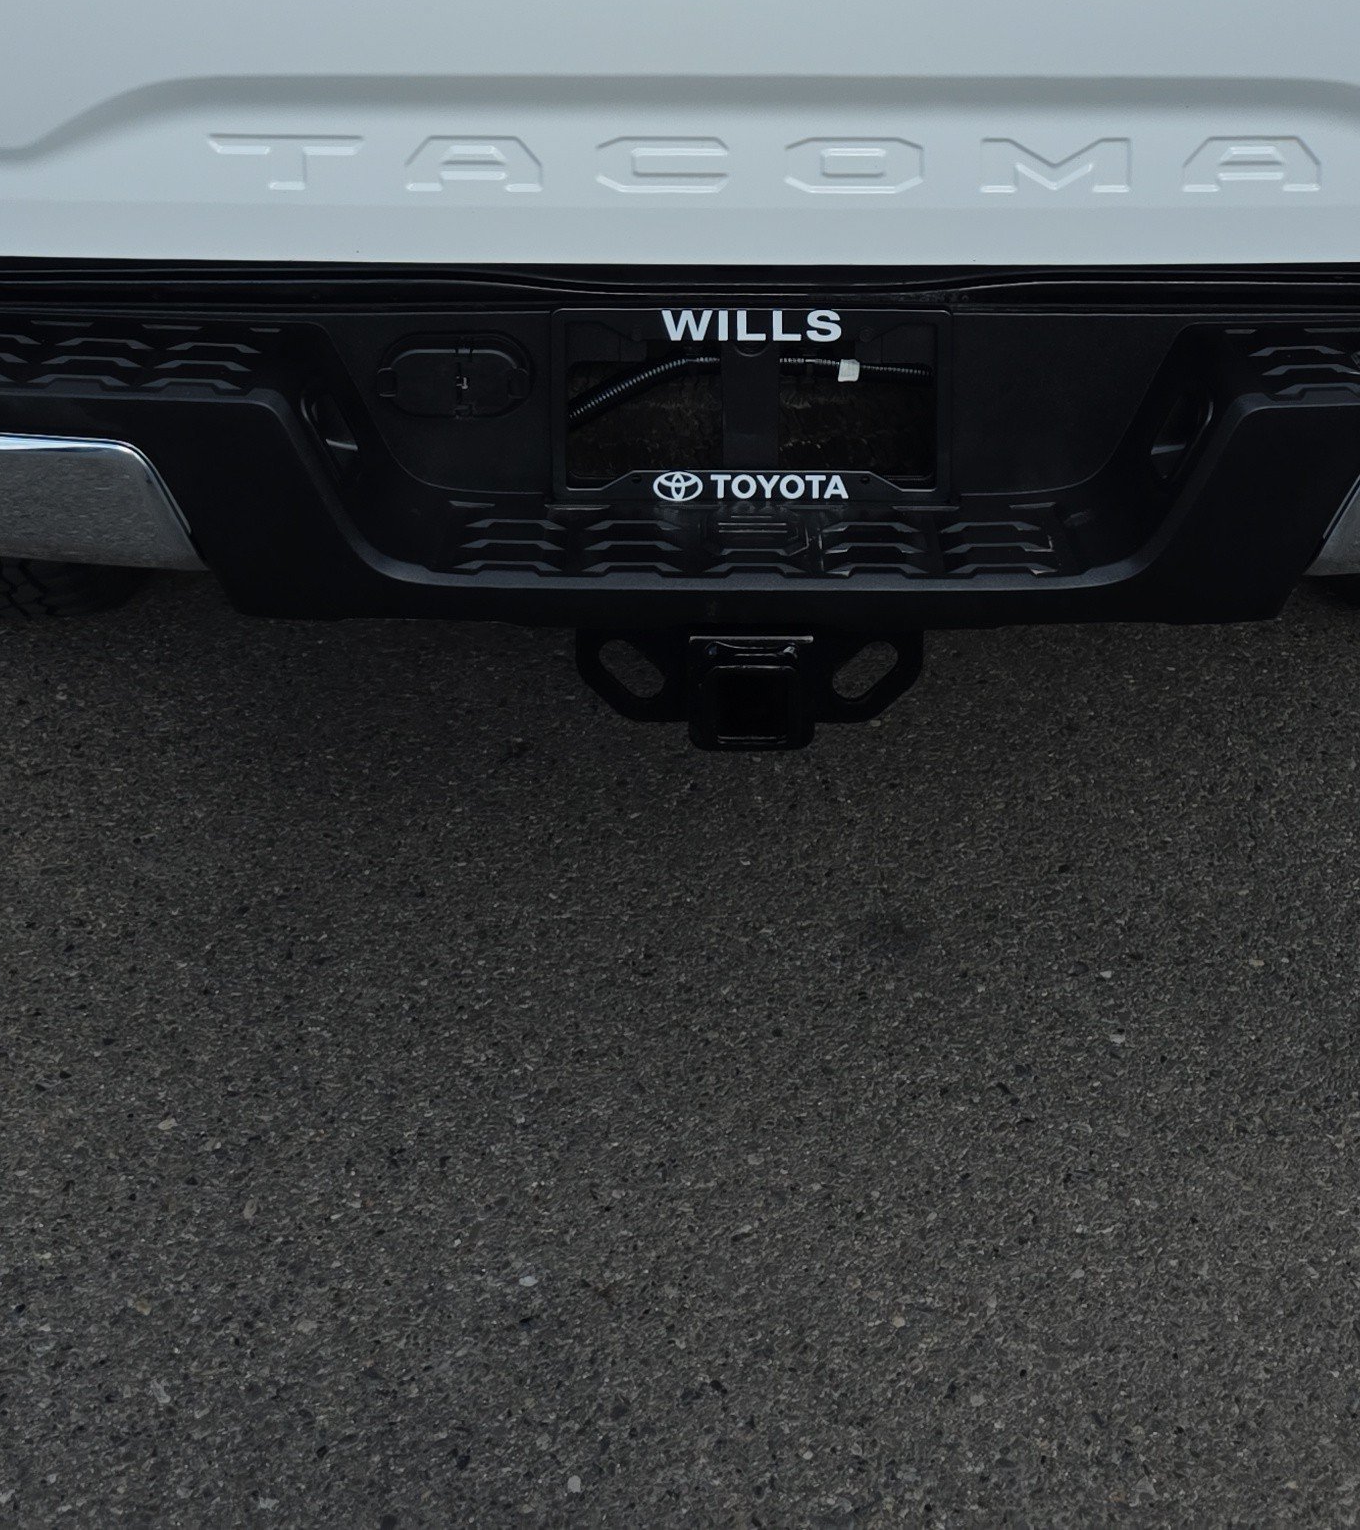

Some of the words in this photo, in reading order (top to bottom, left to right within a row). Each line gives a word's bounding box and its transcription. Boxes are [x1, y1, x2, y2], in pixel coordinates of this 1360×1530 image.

[208, 133, 1323, 193] TACOMA
[661, 309, 842, 342] WILLS
[710, 474, 849, 500] TOYOTA
